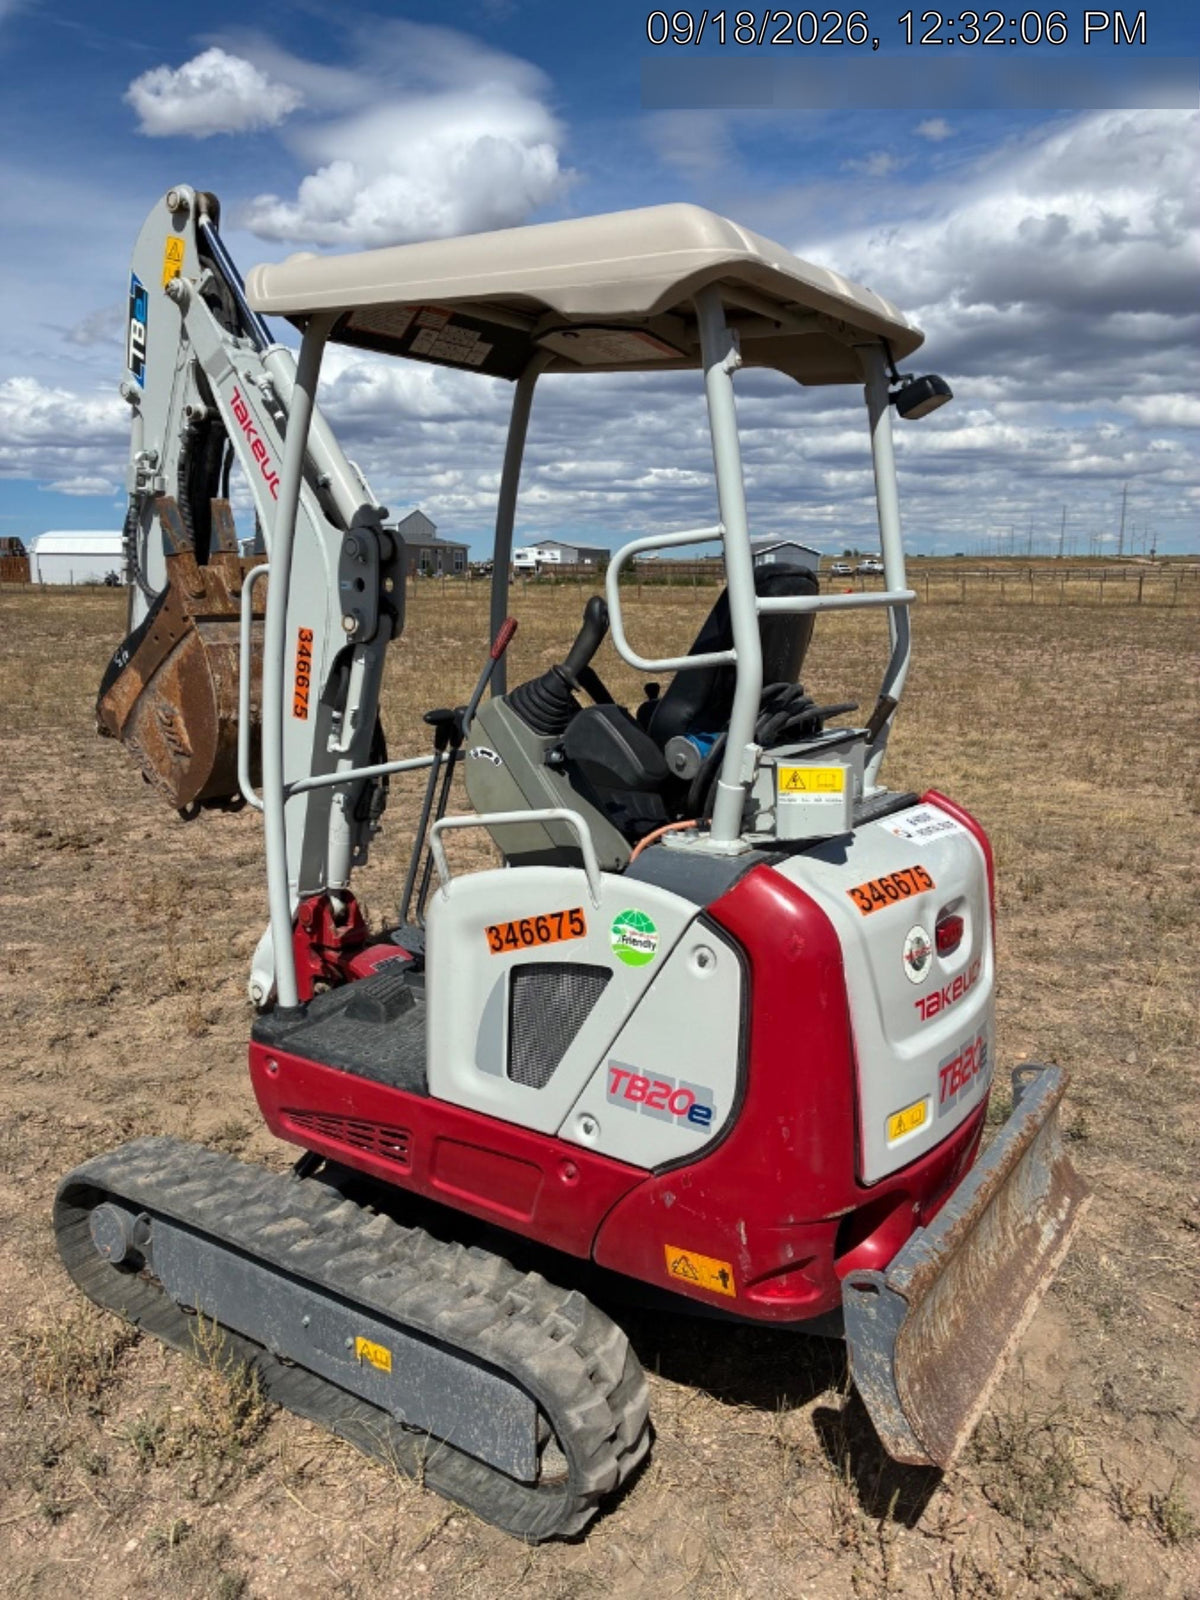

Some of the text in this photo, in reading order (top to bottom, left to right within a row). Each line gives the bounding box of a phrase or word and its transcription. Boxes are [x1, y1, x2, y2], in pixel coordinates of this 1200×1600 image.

[293, 627, 313, 720] 346675
[850, 864, 933, 912] 346675
[487, 907, 585, 951] 346675
[621, 934, 657, 952] Friendly
[609, 1066, 712, 1126] TB20e
